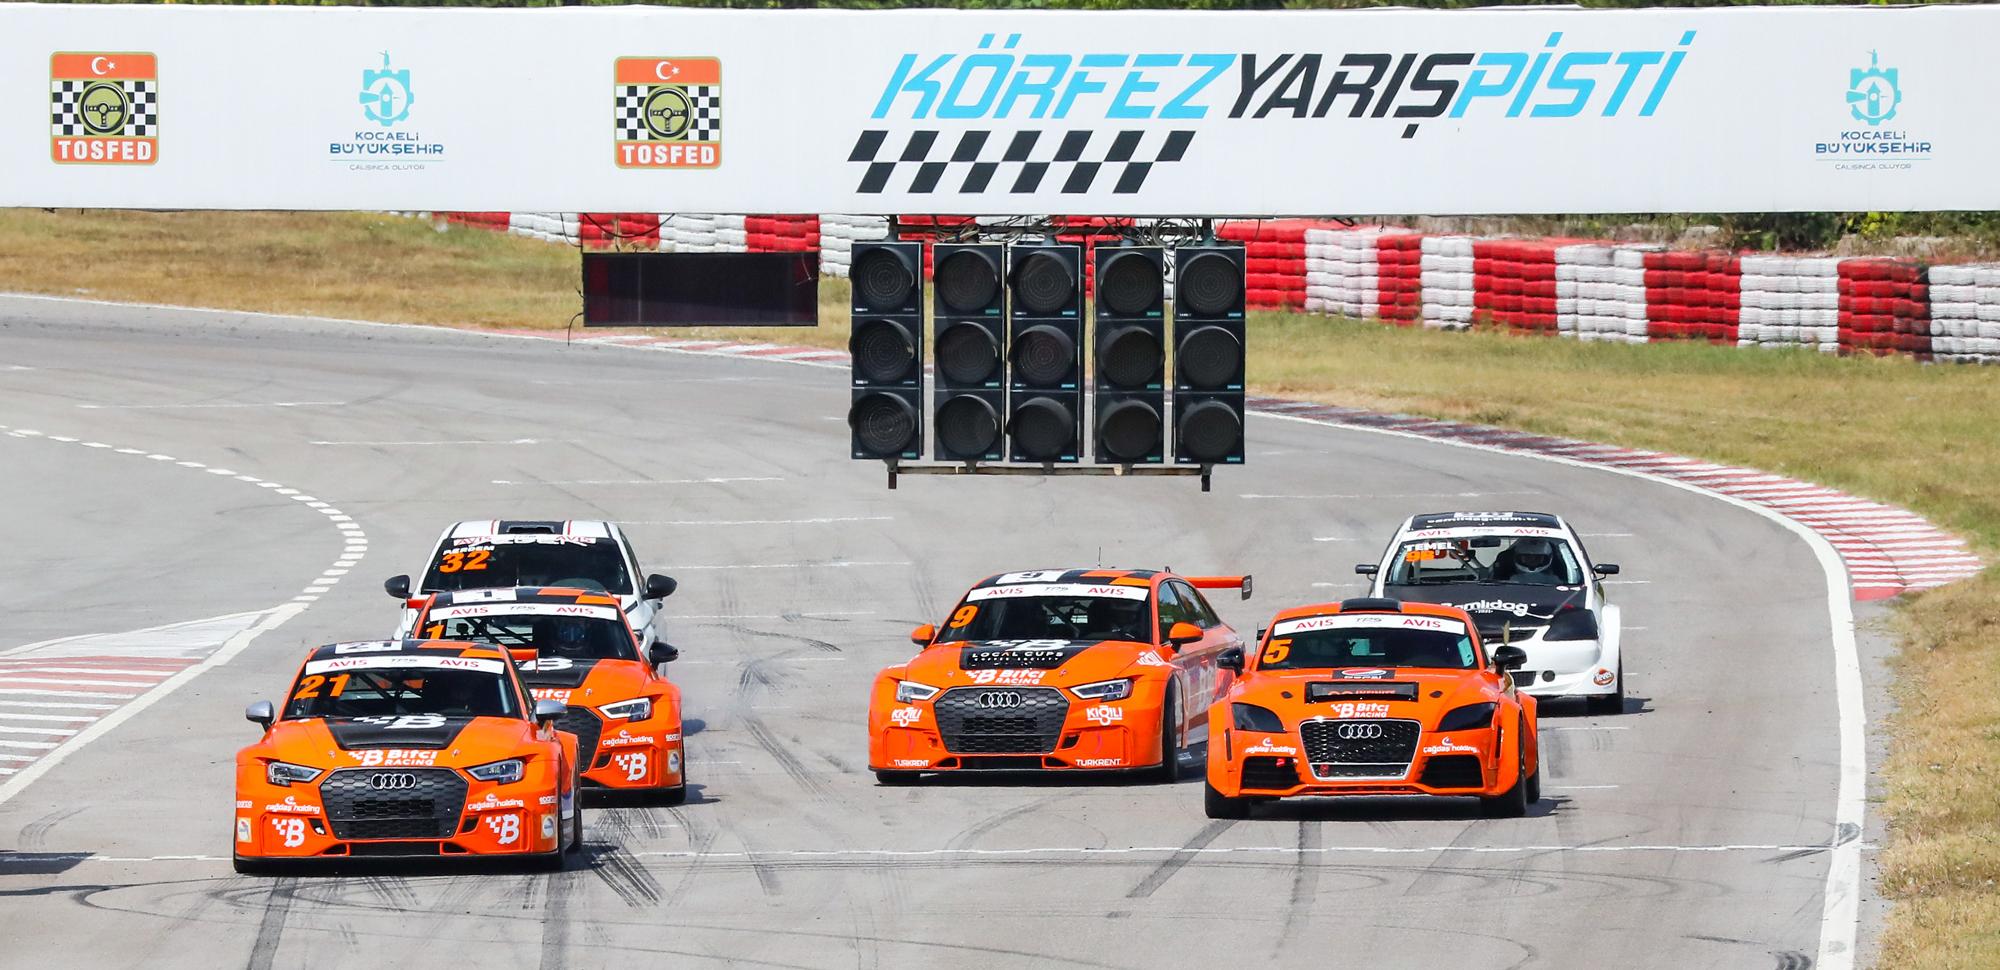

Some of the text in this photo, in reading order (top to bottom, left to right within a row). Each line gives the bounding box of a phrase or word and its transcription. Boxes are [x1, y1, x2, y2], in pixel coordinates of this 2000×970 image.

[57, 140, 152, 160] TOSFED
[622, 145, 715, 164] TOSFED
[1404, 541, 1456, 552] TEMEL
[439, 550, 491, 573] 32
[987, 587, 1024, 597] AVIS
[1087, 587, 1125, 596] AVIS
[451, 606, 489, 616] AVIS
[556, 606, 595, 615] AVIS
[950, 605, 979, 629] 9
[1295, 618, 1334, 629] AVIS
[1402, 618, 1441, 628] AVIS
[426, 624, 447, 640] 1
[1263, 638, 1294, 664] 5
[328, 658, 368, 668] AVIS
[439, 659, 480, 668] AVIS
[293, 673, 351, 701] 21
[629, 735, 654, 745] holding
[1075, 758, 1122, 767] TURKRENT
